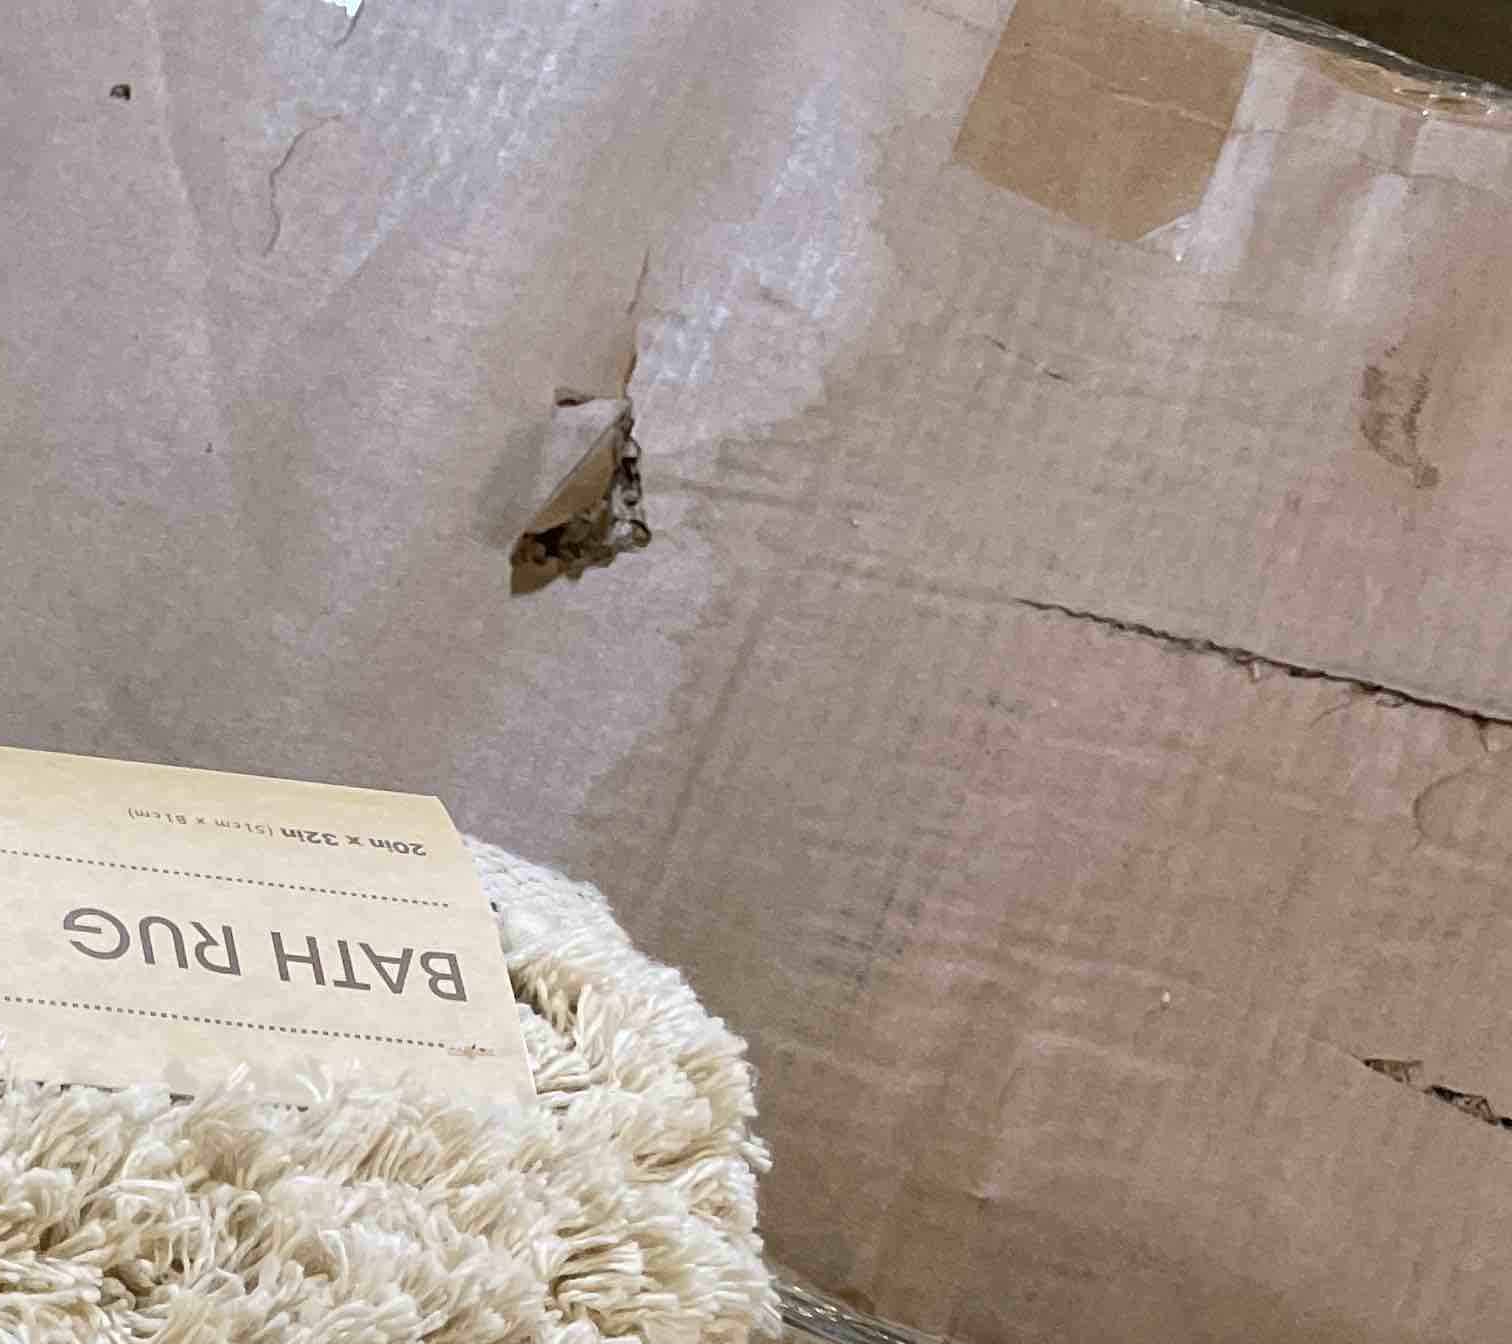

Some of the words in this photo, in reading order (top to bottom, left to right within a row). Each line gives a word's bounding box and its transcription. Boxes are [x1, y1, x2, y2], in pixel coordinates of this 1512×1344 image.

[214, 818, 273, 837] (51cm
[279, 826, 339, 847] 32in
[344, 834, 363, 846] x
[369, 836, 427, 857] 20in
[63, 907, 242, 977] RUG
[272, 930, 468, 1002] BATH
